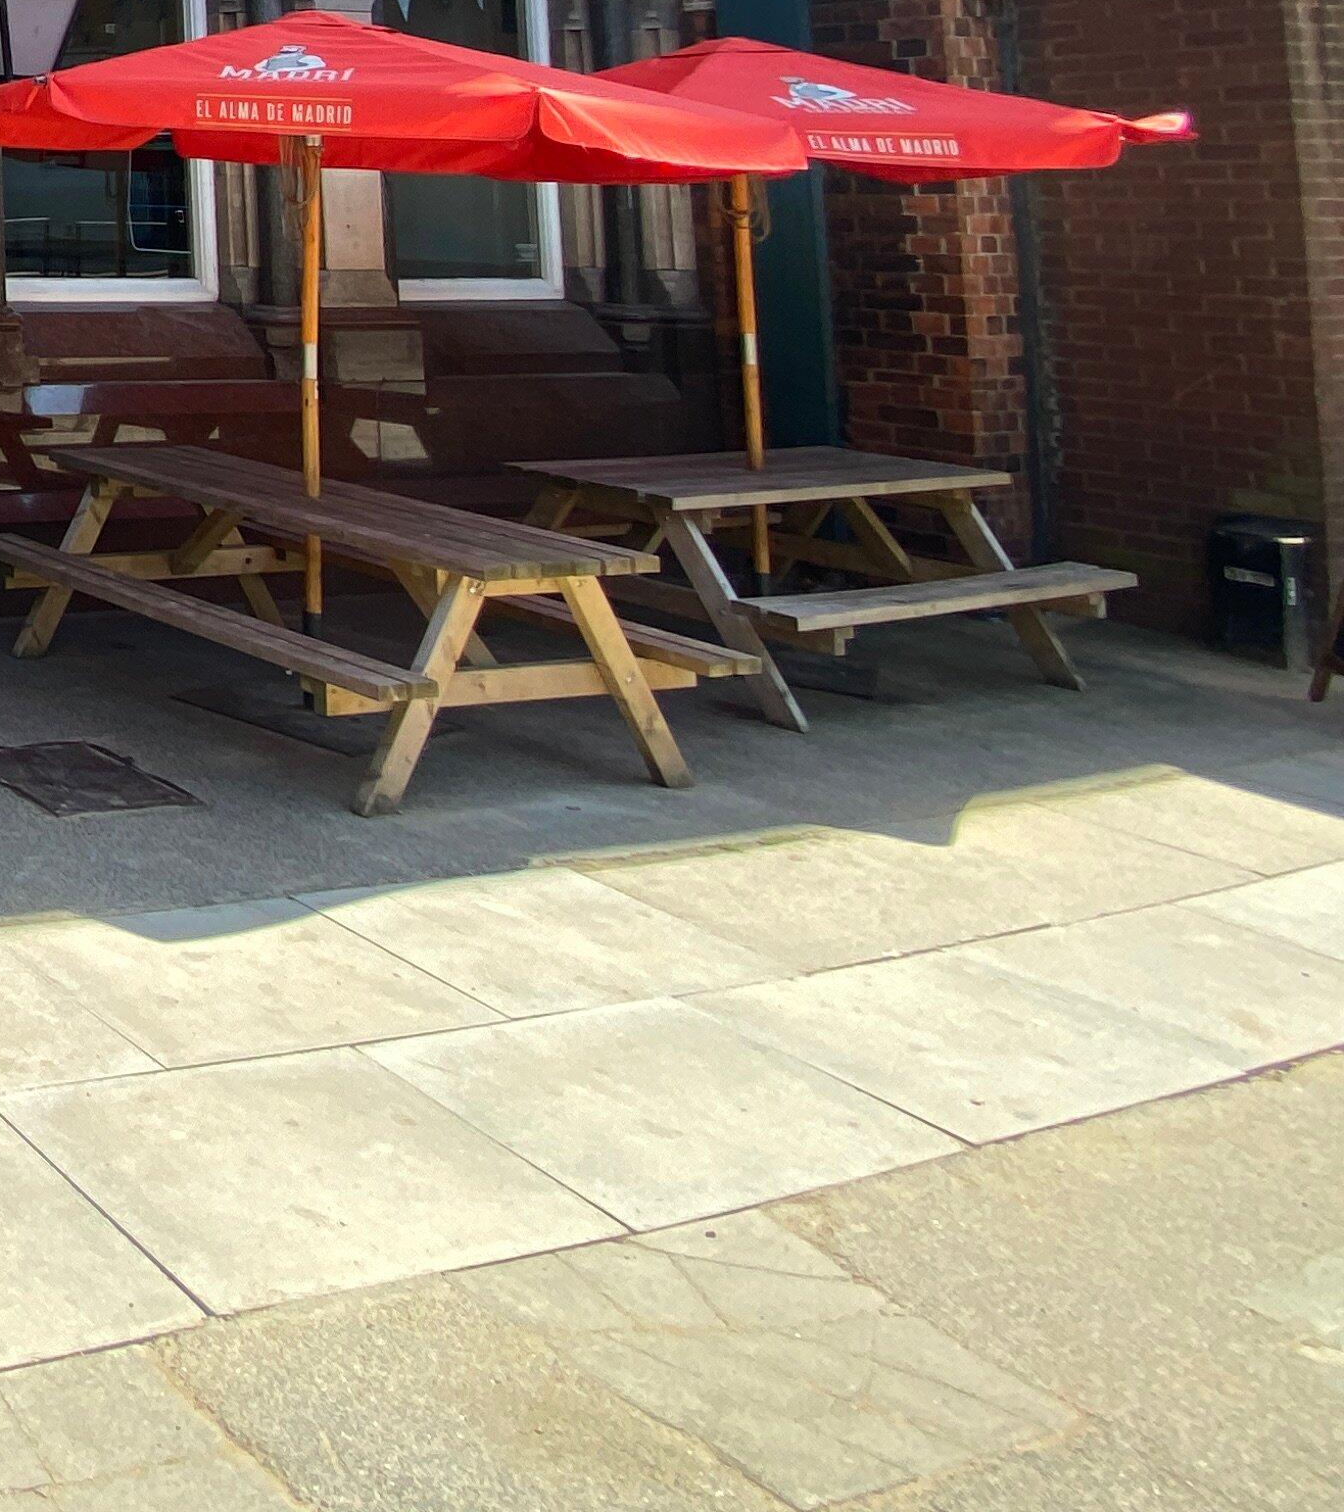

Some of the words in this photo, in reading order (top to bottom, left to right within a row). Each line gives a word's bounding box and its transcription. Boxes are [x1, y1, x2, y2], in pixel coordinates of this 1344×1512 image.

[196, 99, 212, 118] EL
[219, 101, 260, 121] ALMA
[267, 102, 285, 122] DE
[291, 103, 353, 125] MADRID
[807, 135, 828, 150] EL
[831, 136, 872, 153] ALMA
[876, 138, 897, 154] DE
[899, 139, 960, 157] MADRID
